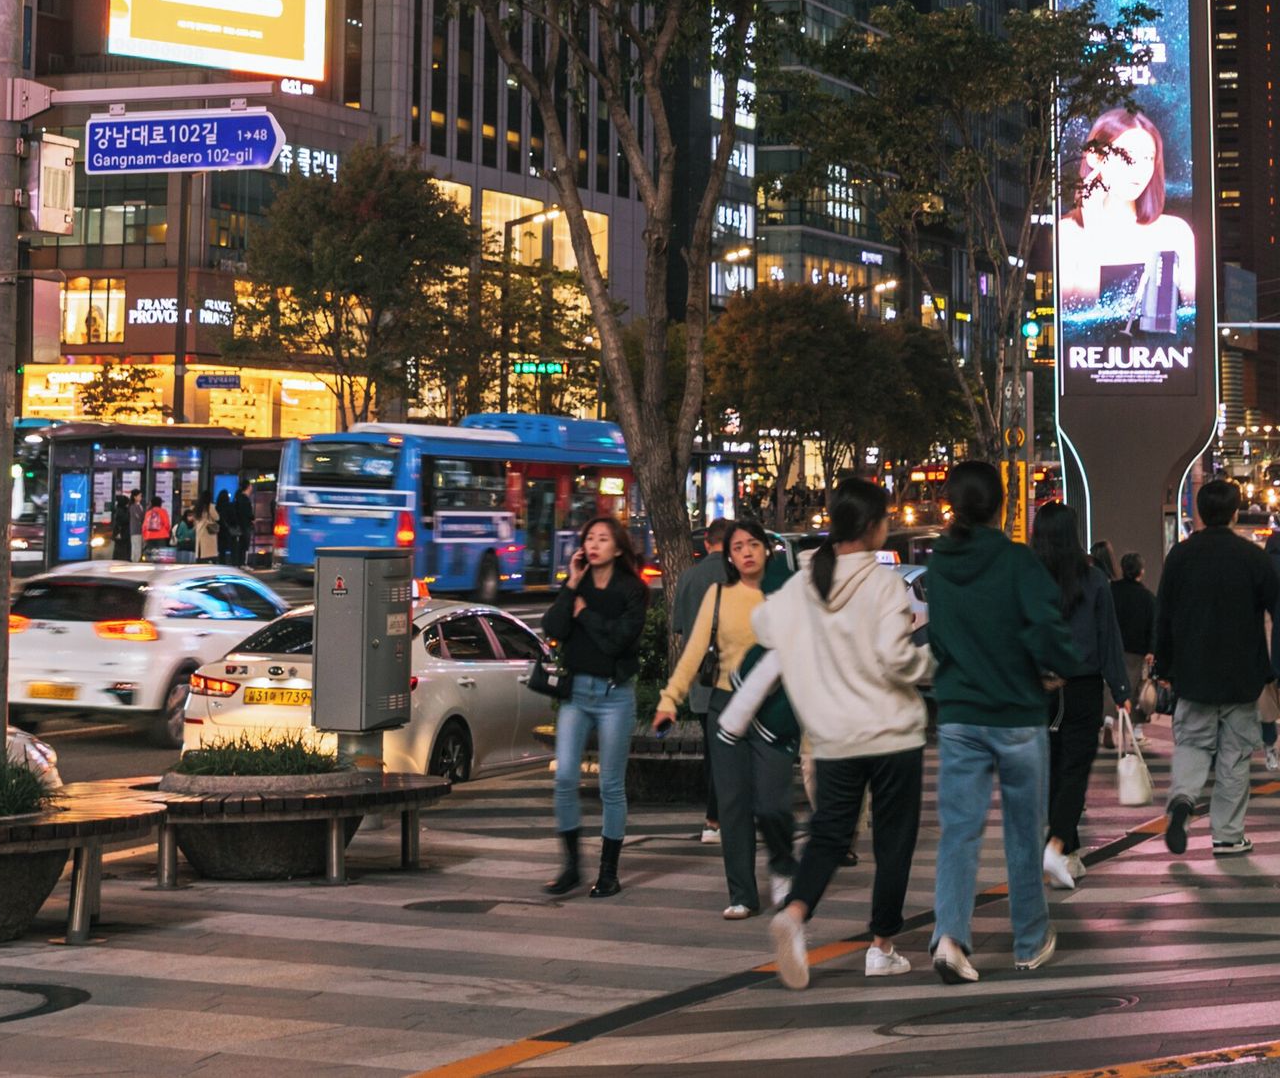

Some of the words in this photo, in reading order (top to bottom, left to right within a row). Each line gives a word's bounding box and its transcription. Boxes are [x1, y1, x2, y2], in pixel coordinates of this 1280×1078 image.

[93, 122, 218, 150] 강남대로102길
[93, 150, 202, 169] Gangnam-daero
[207, 148, 253, 165] 102-gil
[137, 298, 178, 311] FRANC
[129, 309, 193, 324] PROVOT
[1070, 346, 1191, 369] REJURAN
[280, 691, 308, 703] 1739
